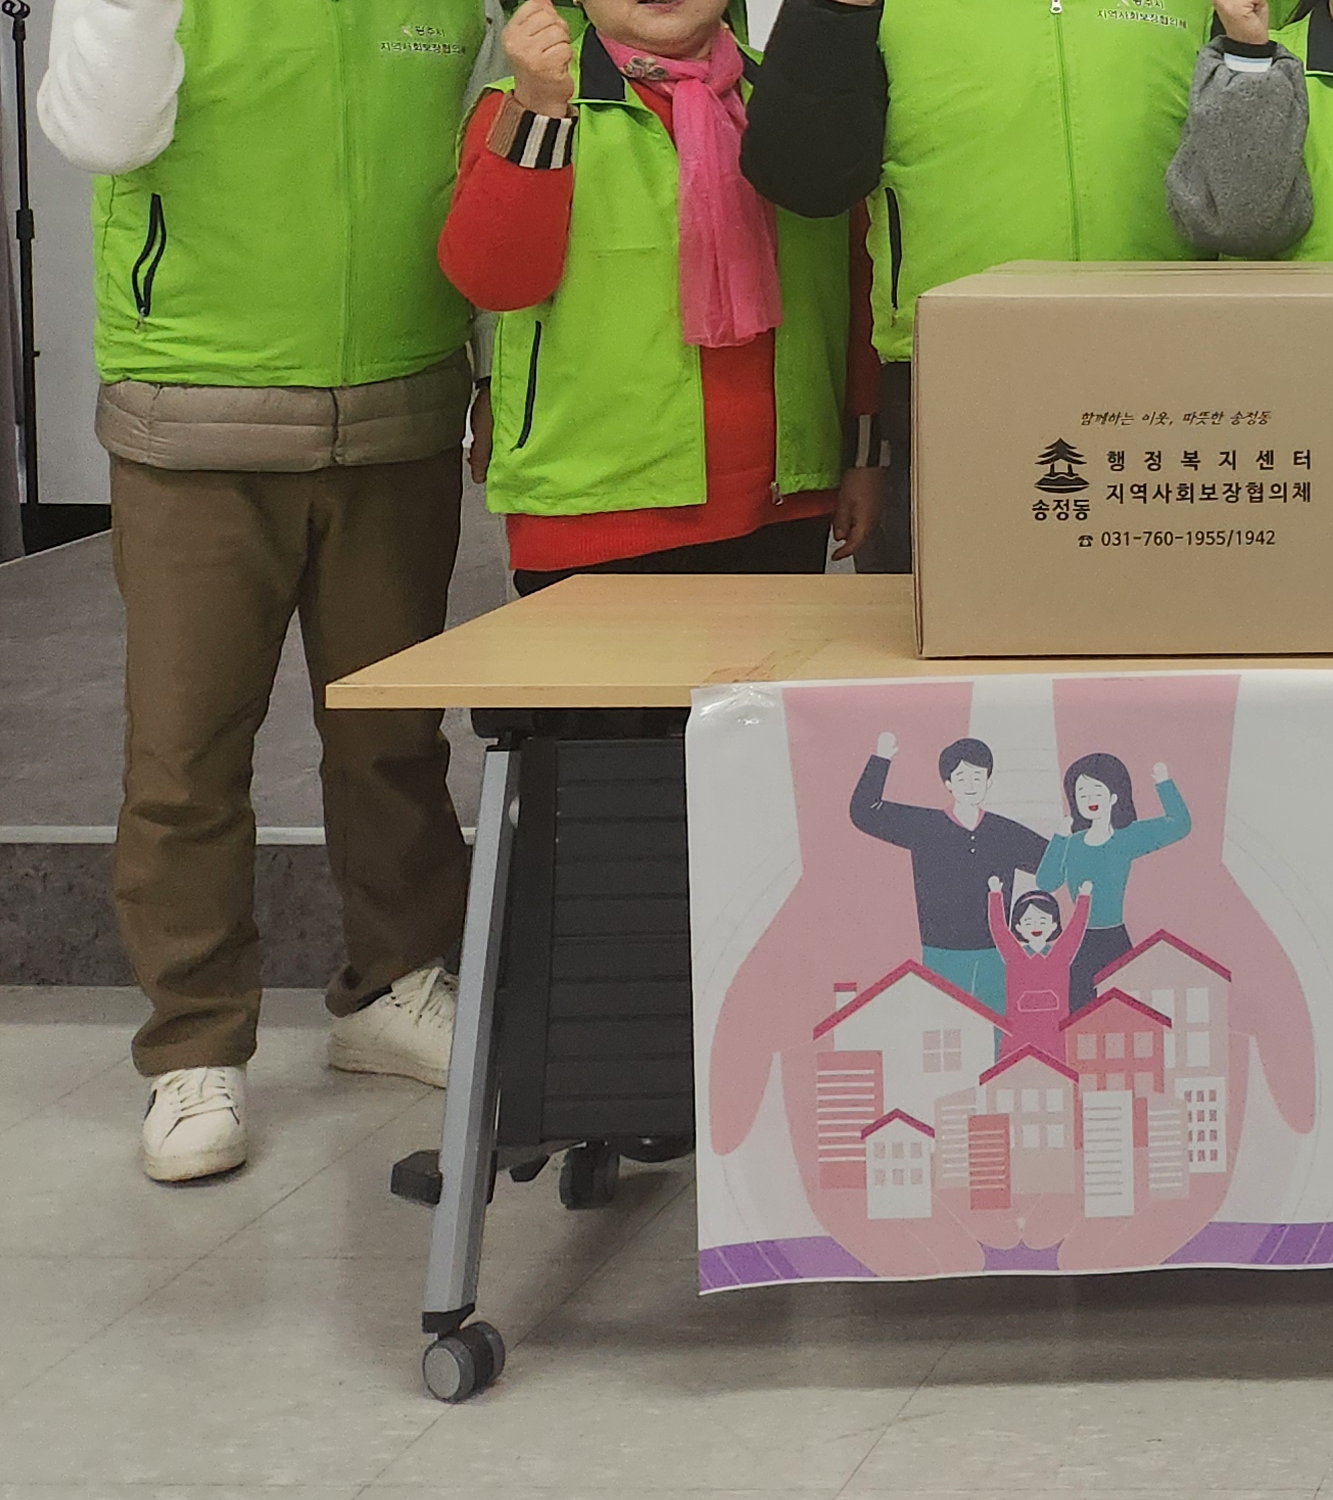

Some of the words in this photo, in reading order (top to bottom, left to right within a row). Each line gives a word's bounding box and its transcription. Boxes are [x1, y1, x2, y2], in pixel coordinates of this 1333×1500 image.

[1081, 411, 1135, 426] 함께하는
[1182, 410, 1224, 426] 따뜻한
[1230, 410, 1272, 426] 송정동
[1106, 481, 1312, 504] 지역사회보장협의체
[1032, 498, 1091, 521] 송정동
[1101, 529, 1276, 547] 031-760-1955/1942
